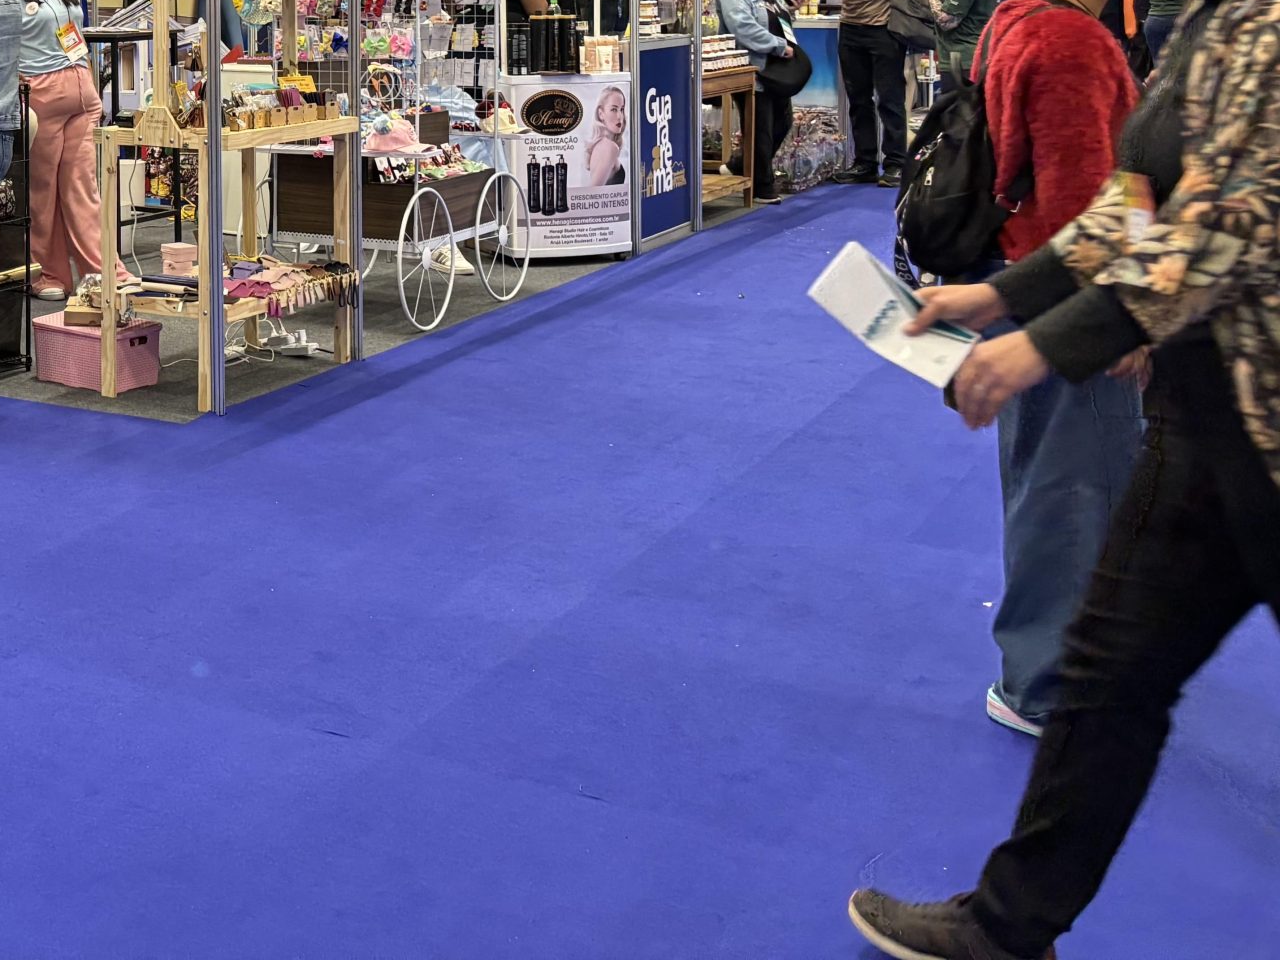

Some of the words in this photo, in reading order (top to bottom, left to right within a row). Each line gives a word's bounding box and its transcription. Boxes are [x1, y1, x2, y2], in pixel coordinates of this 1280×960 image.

[524, 136, 578, 145] CAUTERIZAÇÃO
[570, 193, 609, 201] CRESCIMENTO
[570, 201, 600, 211] BRILHO
[601, 198, 629, 209] INTENSO
